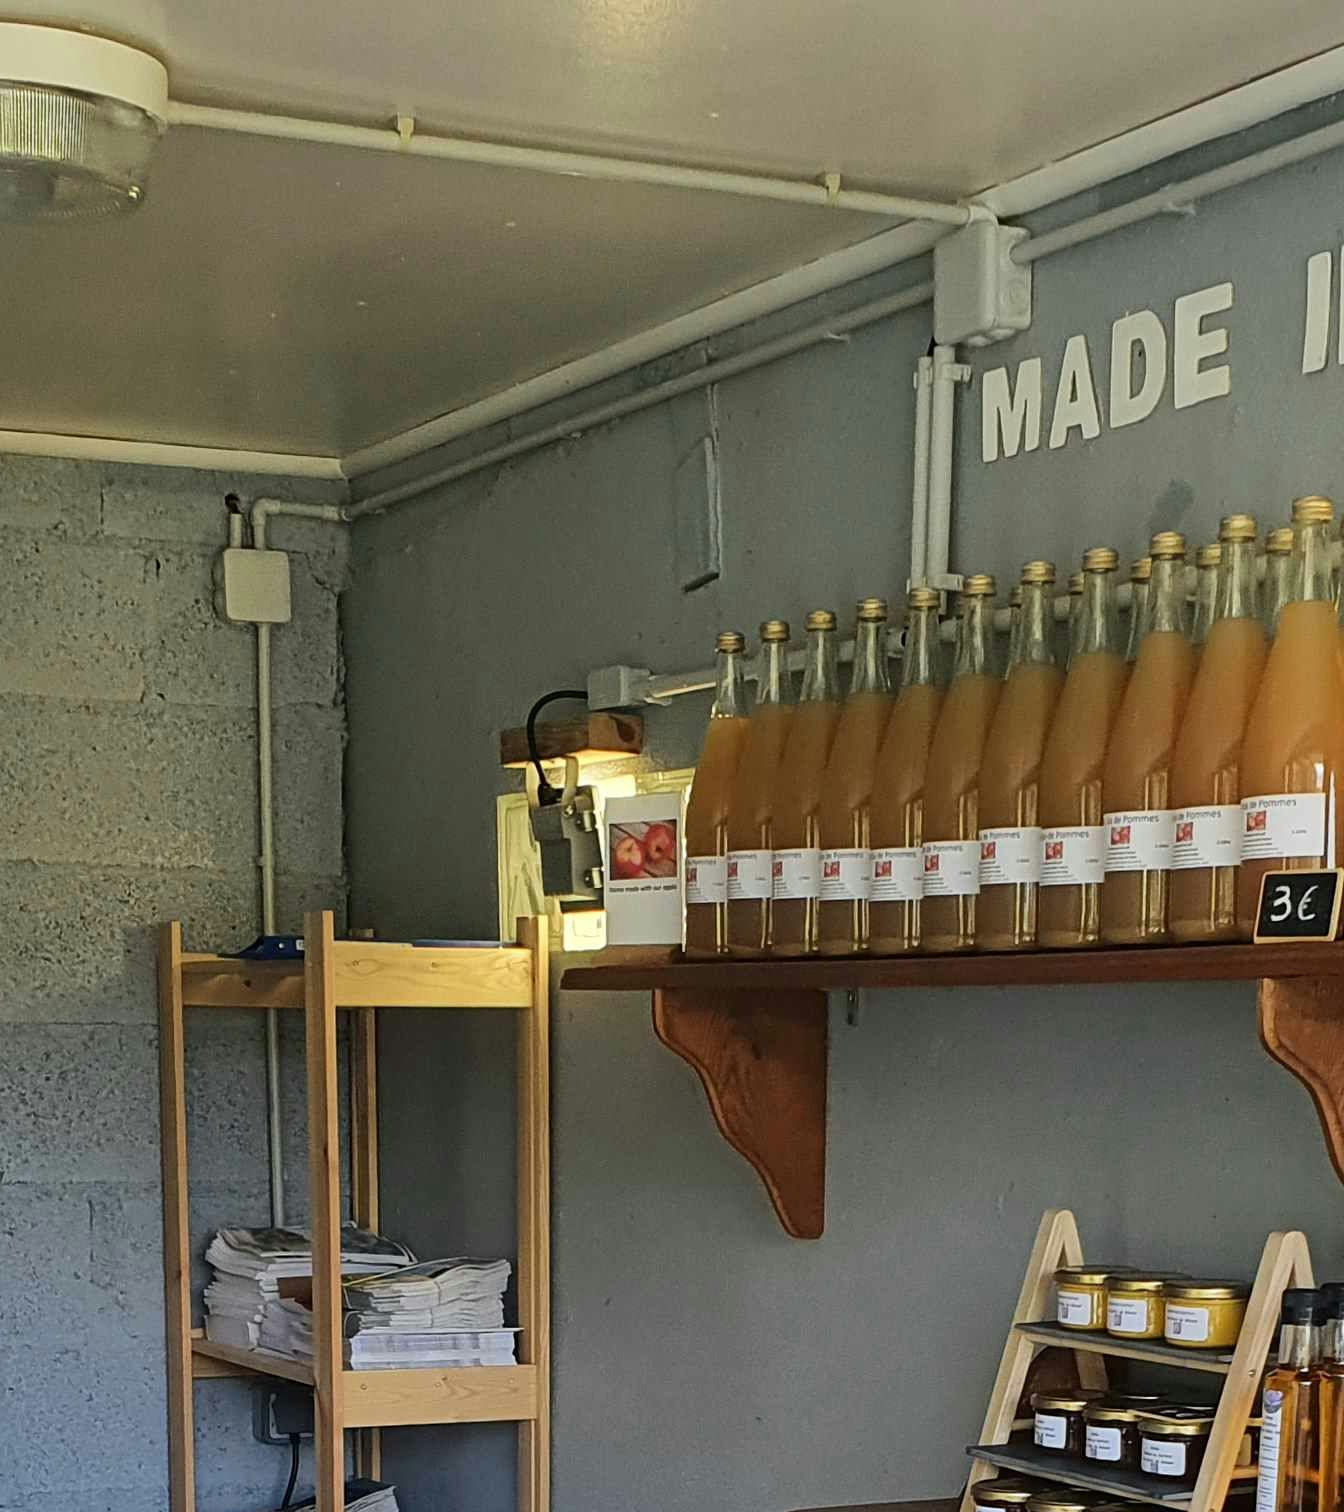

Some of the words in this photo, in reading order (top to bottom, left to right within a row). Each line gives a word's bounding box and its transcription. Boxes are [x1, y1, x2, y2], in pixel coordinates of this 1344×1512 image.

[982, 282, 1234, 464] MADE
[1258, 799, 1297, 809] Pommes
[1123, 815, 1159, 823] Pommes
[1186, 811, 1221, 819] Pommes
